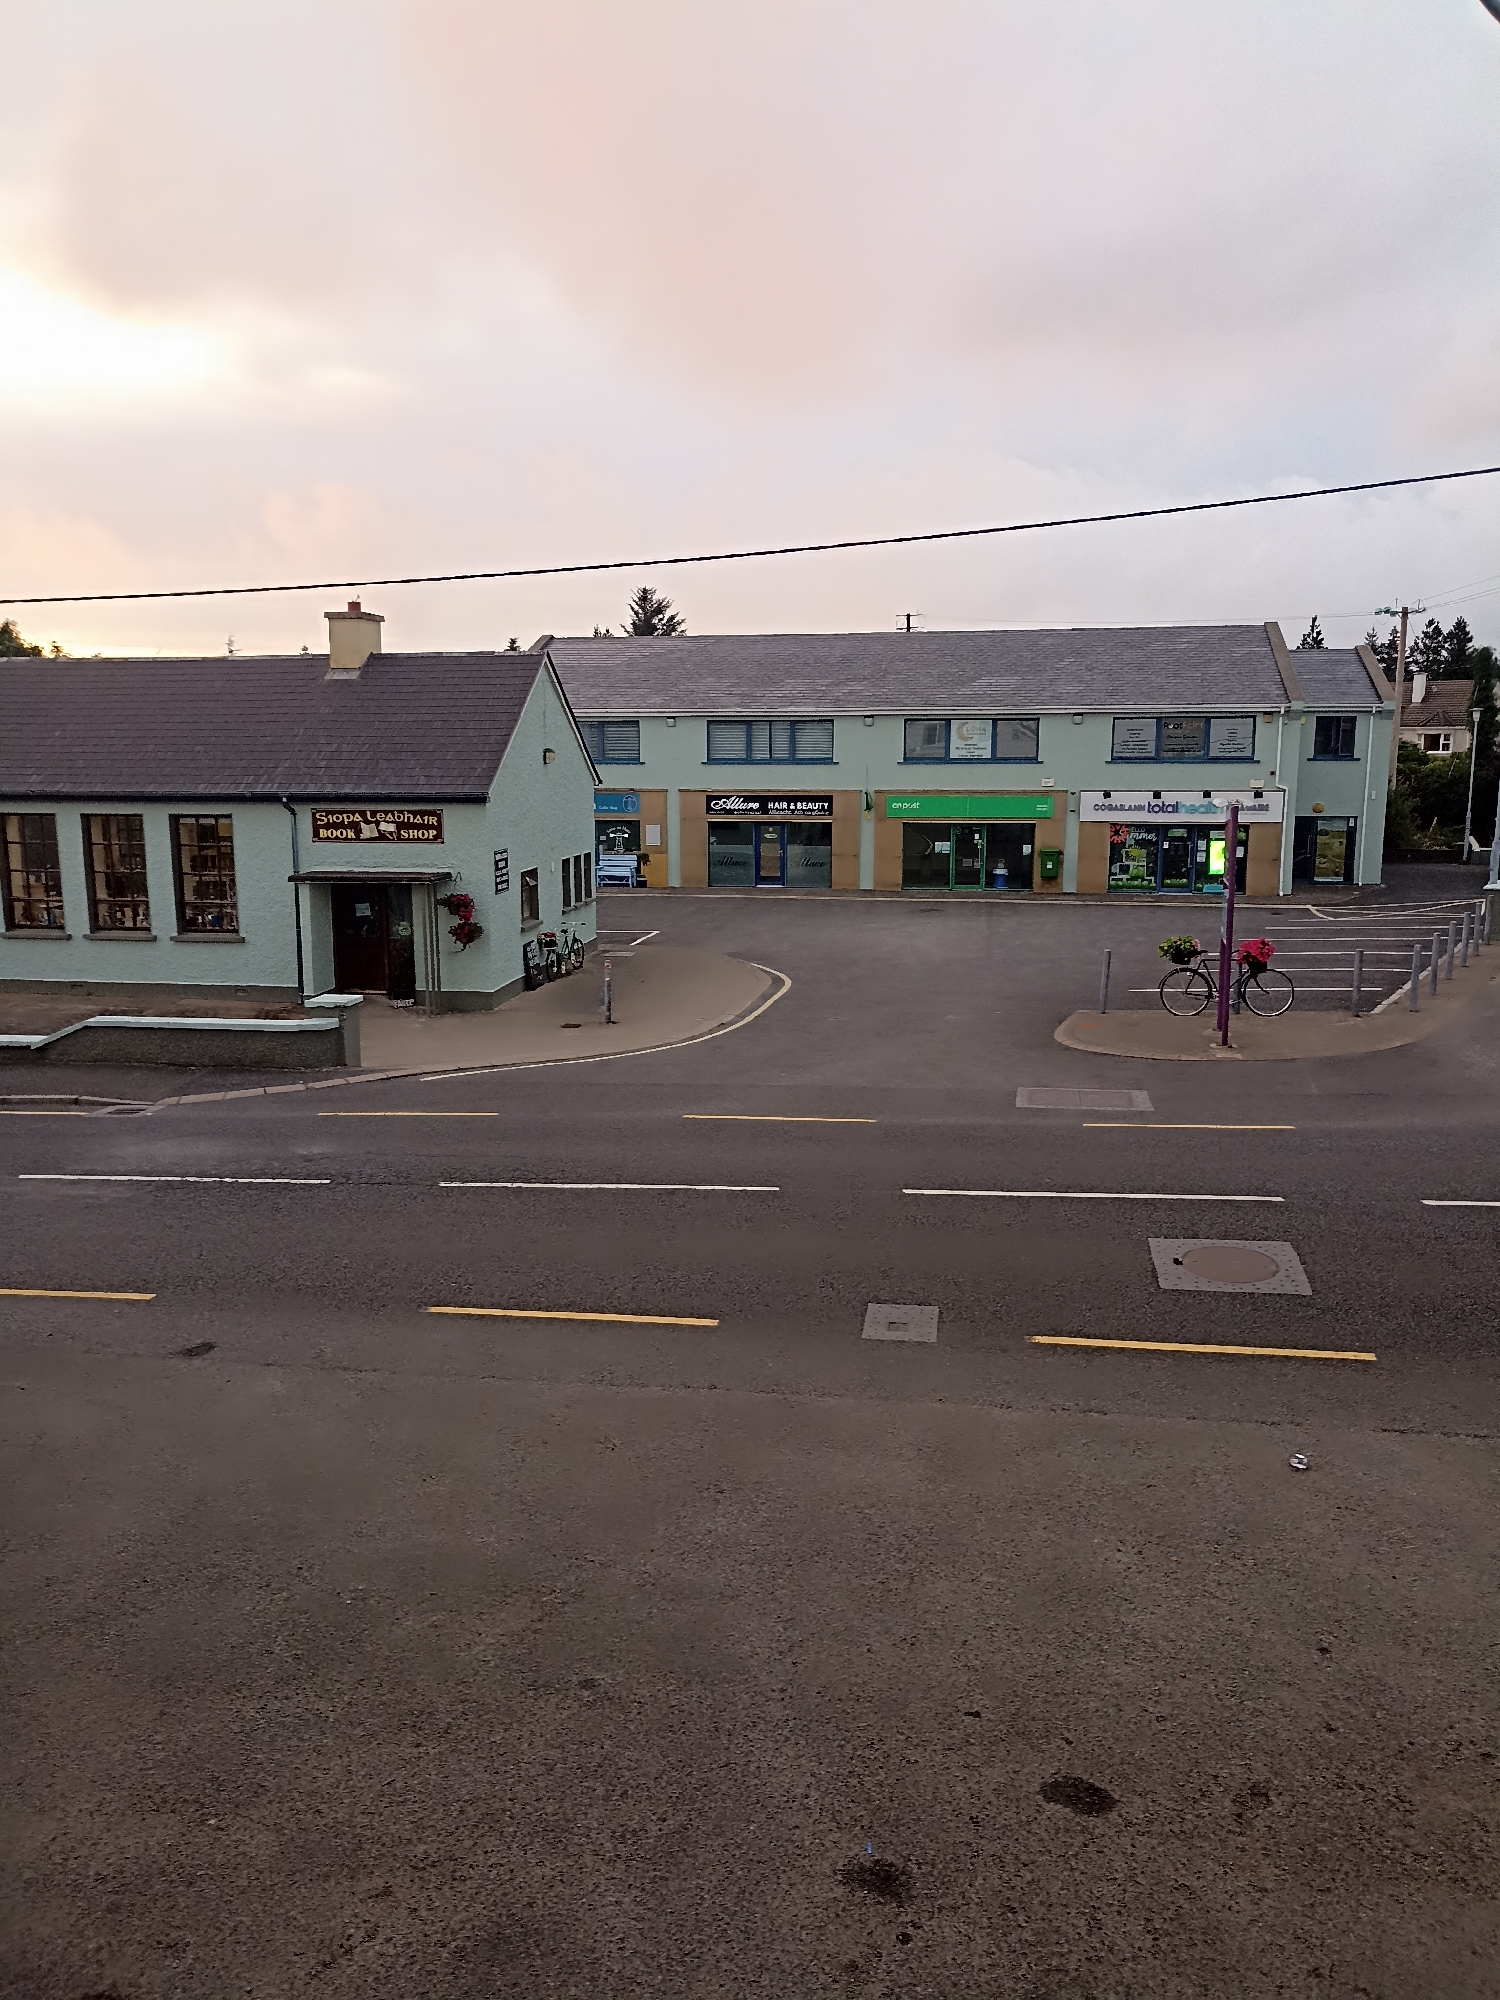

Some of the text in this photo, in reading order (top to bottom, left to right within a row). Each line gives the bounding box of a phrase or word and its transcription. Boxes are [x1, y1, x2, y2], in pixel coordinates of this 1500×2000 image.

[710, 796, 760, 809] Allure
[797, 802, 829, 810] BEAUTY
[319, 828, 437, 839] BOOK SHOP
